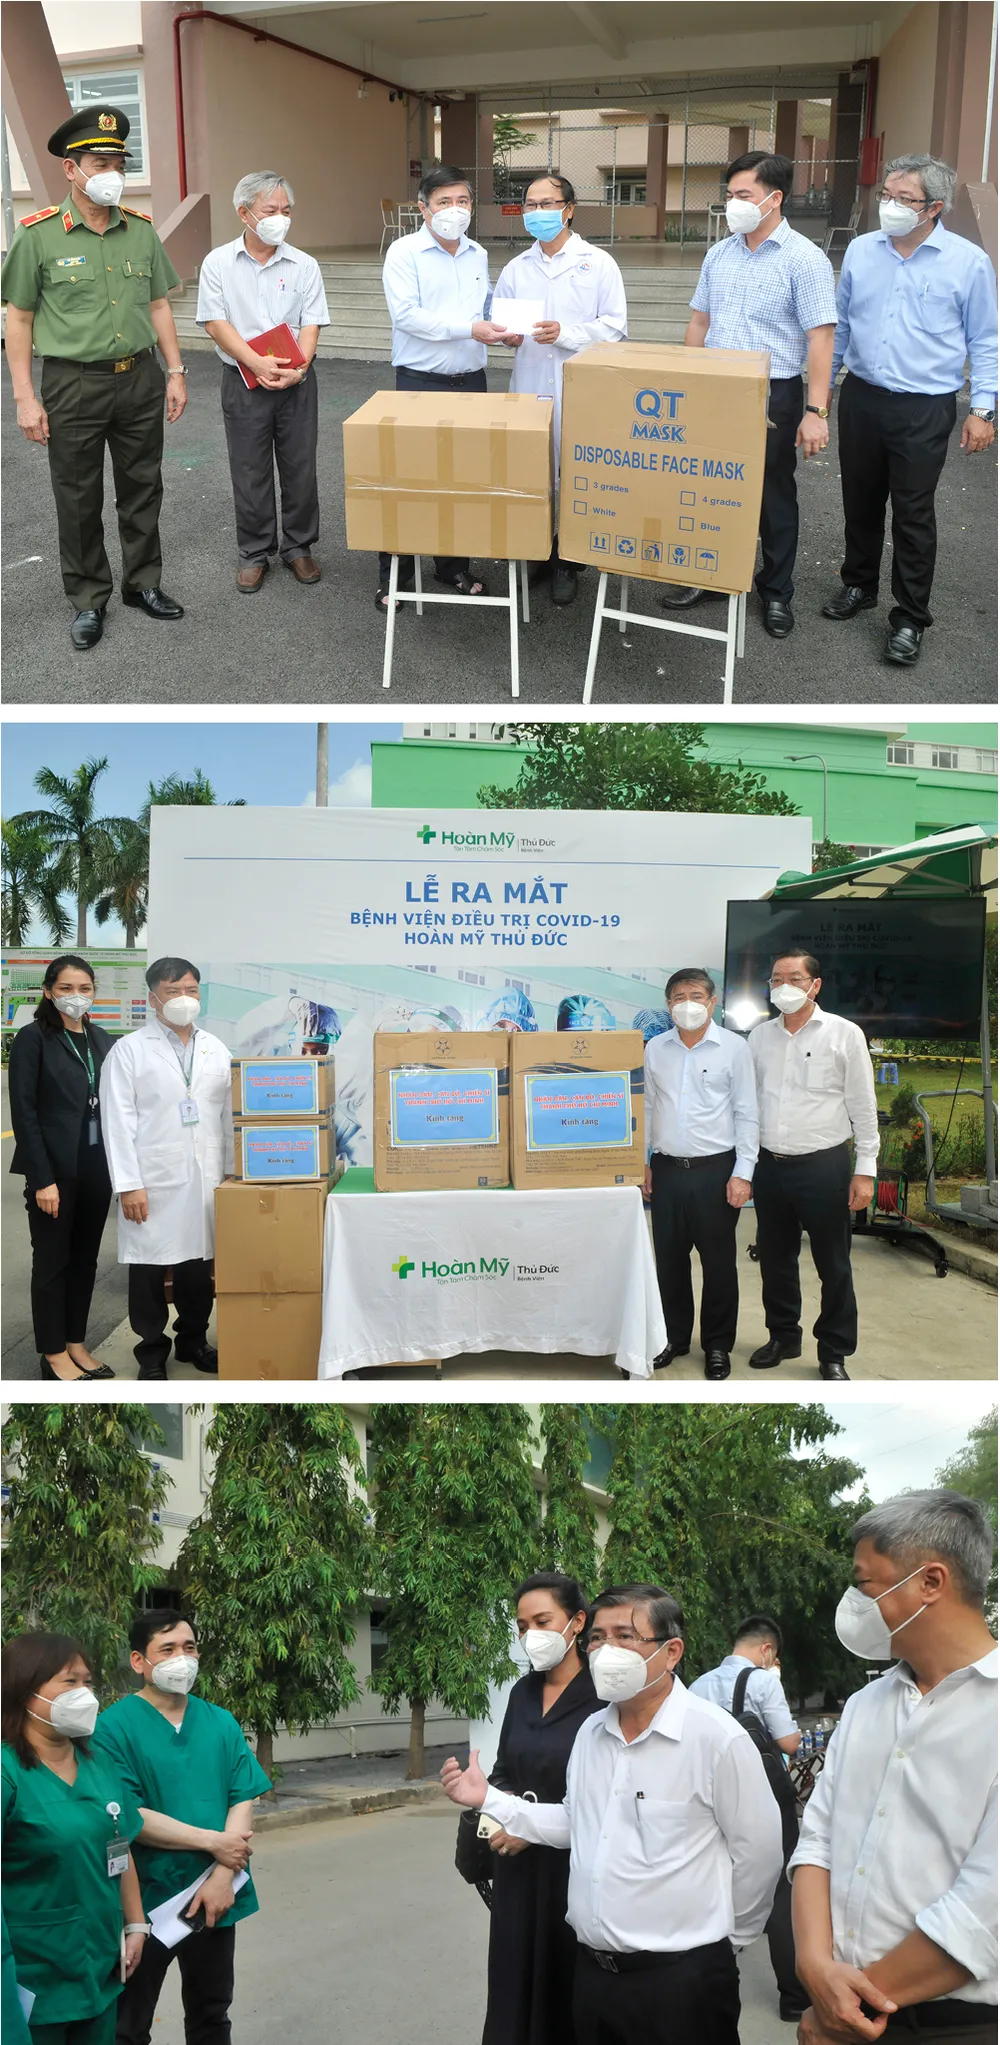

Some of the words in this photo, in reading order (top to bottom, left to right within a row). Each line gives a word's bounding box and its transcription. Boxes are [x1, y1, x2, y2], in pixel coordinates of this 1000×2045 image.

[633, 387, 687, 421] QT
[631, 422, 686, 443] MASK
[574, 444, 658, 471] DISPOSABLE
[662, 455, 698, 476] FACE
[702, 459, 745, 481] MASK
[600, 483, 629, 494] grades
[702, 496, 708, 504] 4
[710, 498, 742, 508] grades
[593, 507, 616, 517] White
[700, 522, 721, 532] Blue
[441, 831, 487, 845] Hoàn
[490, 832, 515, 848] Mỹ
[520, 838, 537, 847] Thủ
[538, 838, 556, 847] Đức
[405, 874, 439, 903] LỄ
[451, 882, 492, 903] RA
[504, 875, 568, 904] MẮT
[350, 908, 397, 928] BỆNH
[403, 909, 446, 929] VIỆN
[451, 909, 495, 926] ĐIỀU
[500, 914, 531, 929] TRỊ
[536, 914, 621, 927] COVID-19
[404, 928, 454, 945] HOÀN
[460, 929, 486, 945] MỸ
[490, 929, 526, 946] THỦ
[531, 929, 568, 946] ĐỨC
[421, 1259, 475, 1278] Hoàn
[479, 1257, 510, 1277] Mỹ
[517, 1264, 537, 1274] Thủ
[539, 1264, 560, 1274] Đức
